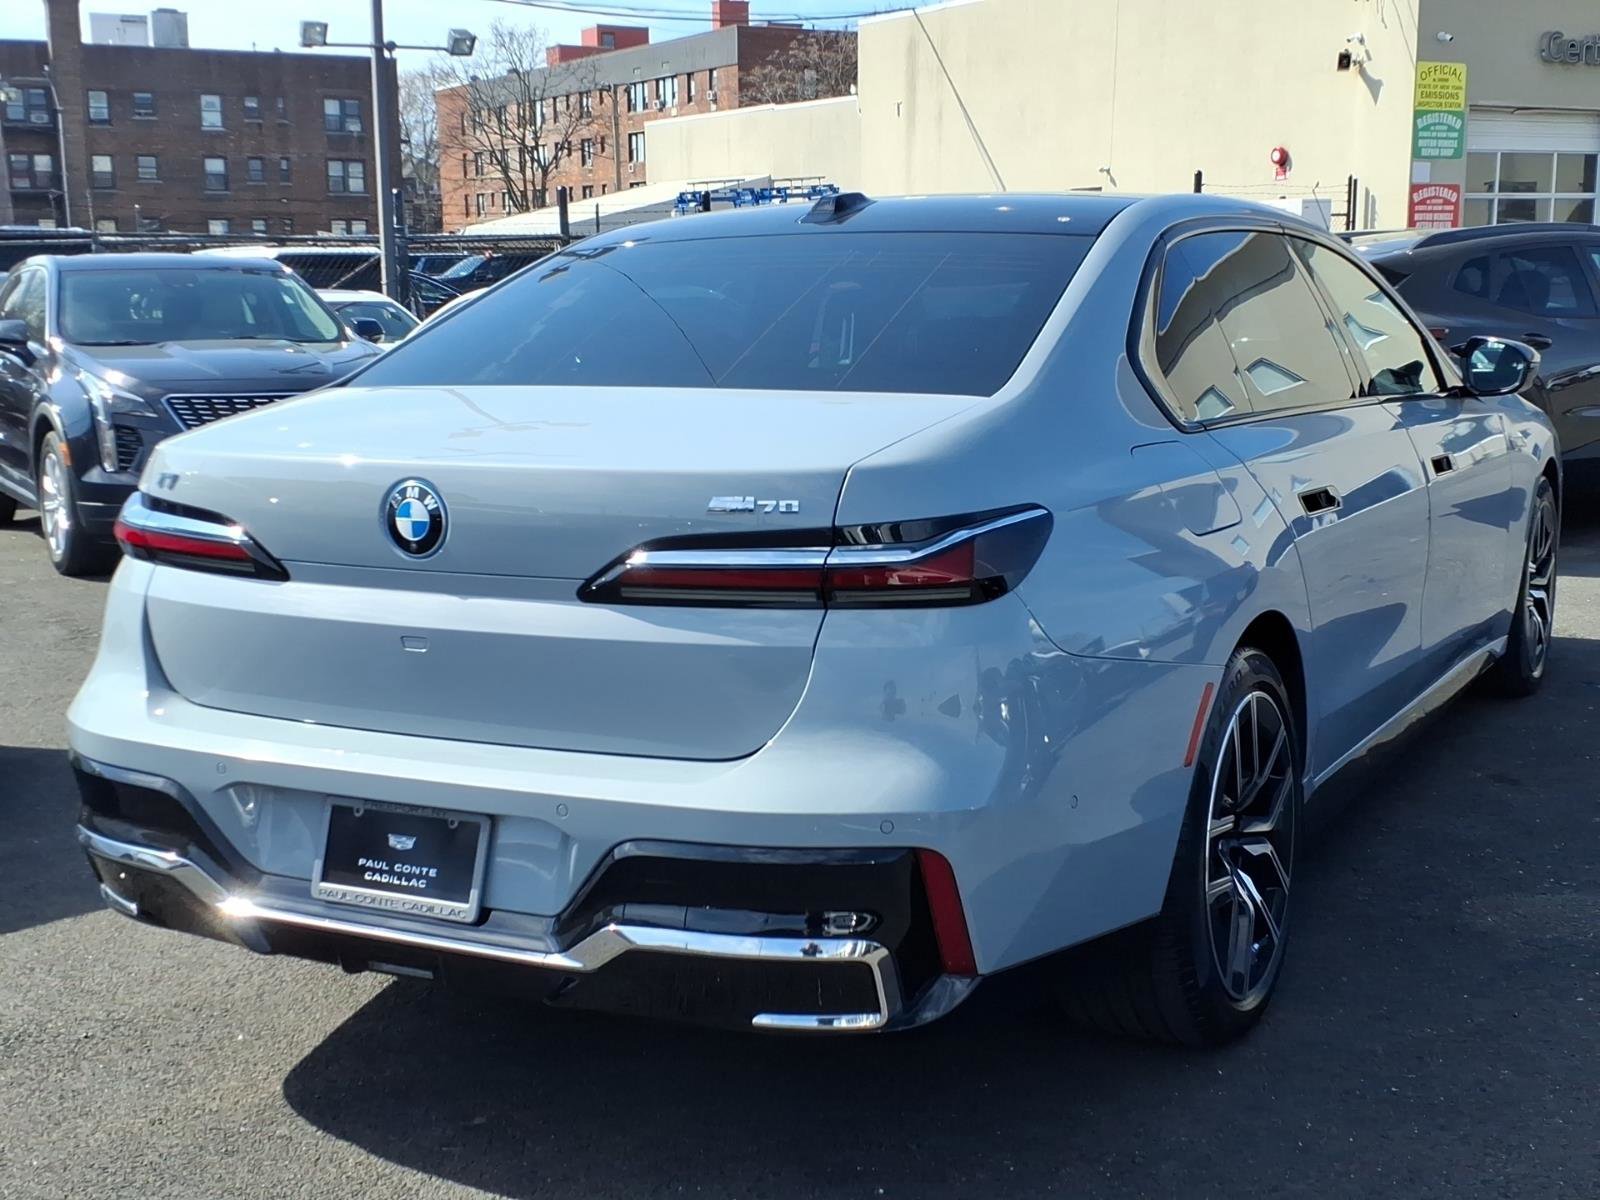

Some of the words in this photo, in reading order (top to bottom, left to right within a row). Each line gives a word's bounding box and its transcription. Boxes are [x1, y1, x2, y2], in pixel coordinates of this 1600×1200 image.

[1420, 64, 1463, 82] OFFICIAL
[1420, 90, 1460, 100] EMISSIONS
[1416, 112, 1462, 129] REGISTERED
[1412, 186, 1458, 203] REGISTERED
[390, 486, 438, 510] BMW
[358, 857, 390, 870] PAUL
[394, 863, 438, 877] CONTE
[363, 871, 427, 888] CADILLAC
[318, 887, 351, 901] PAUL
[354, 893, 399, 910] CONTE
[401, 900, 467, 920] CADILLAC
